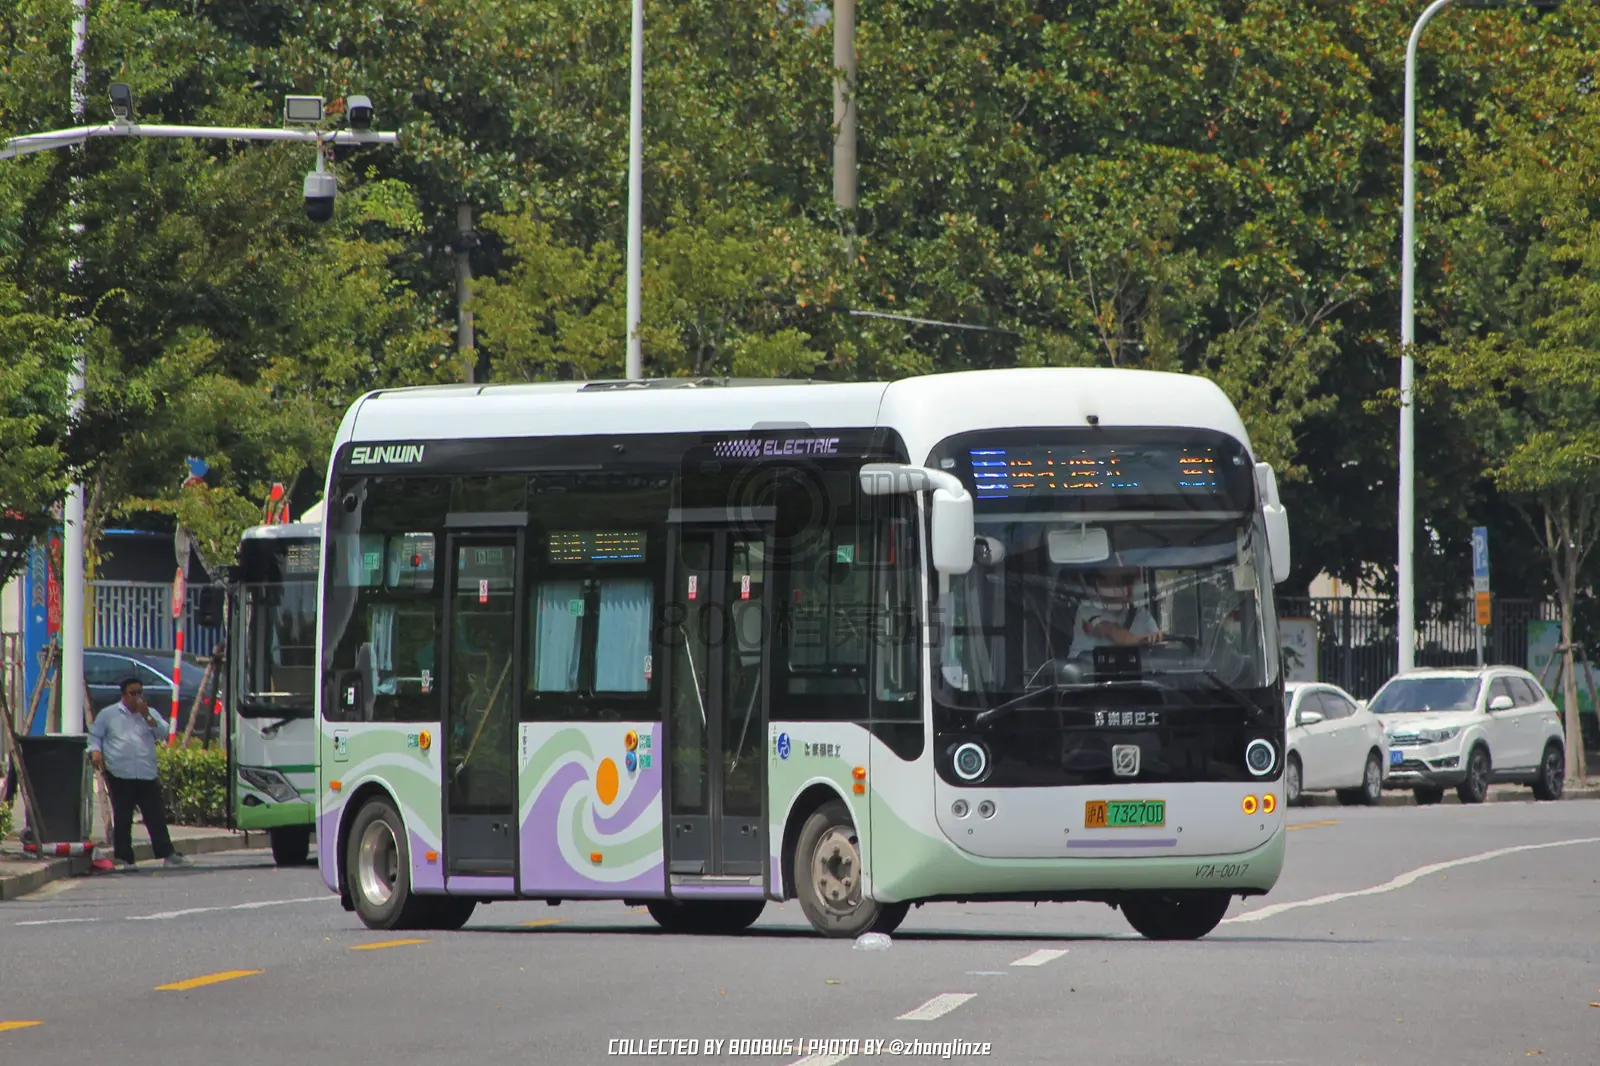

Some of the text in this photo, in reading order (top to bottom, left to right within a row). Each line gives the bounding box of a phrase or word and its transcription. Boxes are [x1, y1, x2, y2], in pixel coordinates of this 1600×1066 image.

[351, 445, 425, 465] SUNWIN
[763, 438, 840, 455] ELECTRIC
[1112, 803, 1164, 823] 73270D
[1195, 863, 1250, 877] V7A-0017
